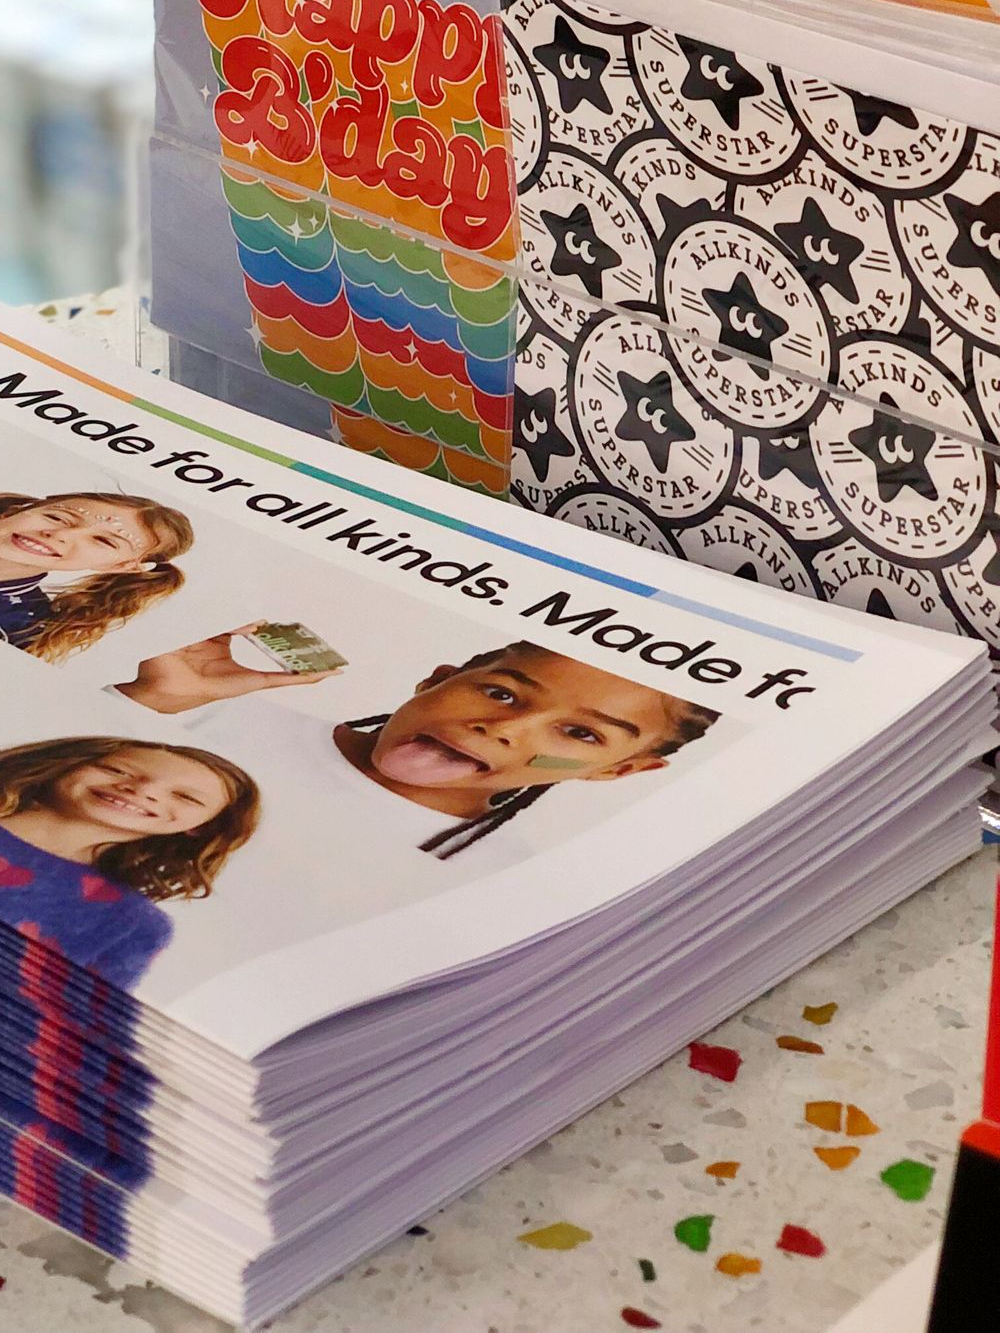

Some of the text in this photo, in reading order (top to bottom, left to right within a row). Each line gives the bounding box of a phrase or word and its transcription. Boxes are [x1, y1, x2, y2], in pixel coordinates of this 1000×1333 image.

[213, 35, 520, 251] B'day
[649, 59, 775, 155] SUPERSTAR
[823, 118, 950, 169] SUPERSTA
[536, 170, 637, 246] ALLKINDS
[756, 166, 870, 224] ALLKINDS
[690, 240, 800, 308] ALLKINDS
[588, 397, 700, 499] SUPERSTAR
[844, 476, 971, 538] SUPERSTAR
[151, 449, 256, 494] for
[246, 493, 349, 530] all
[326, 519, 505, 606] kinds.
[520, 591, 742, 684] Made
[822, 556, 937, 615] ALLKINDS
